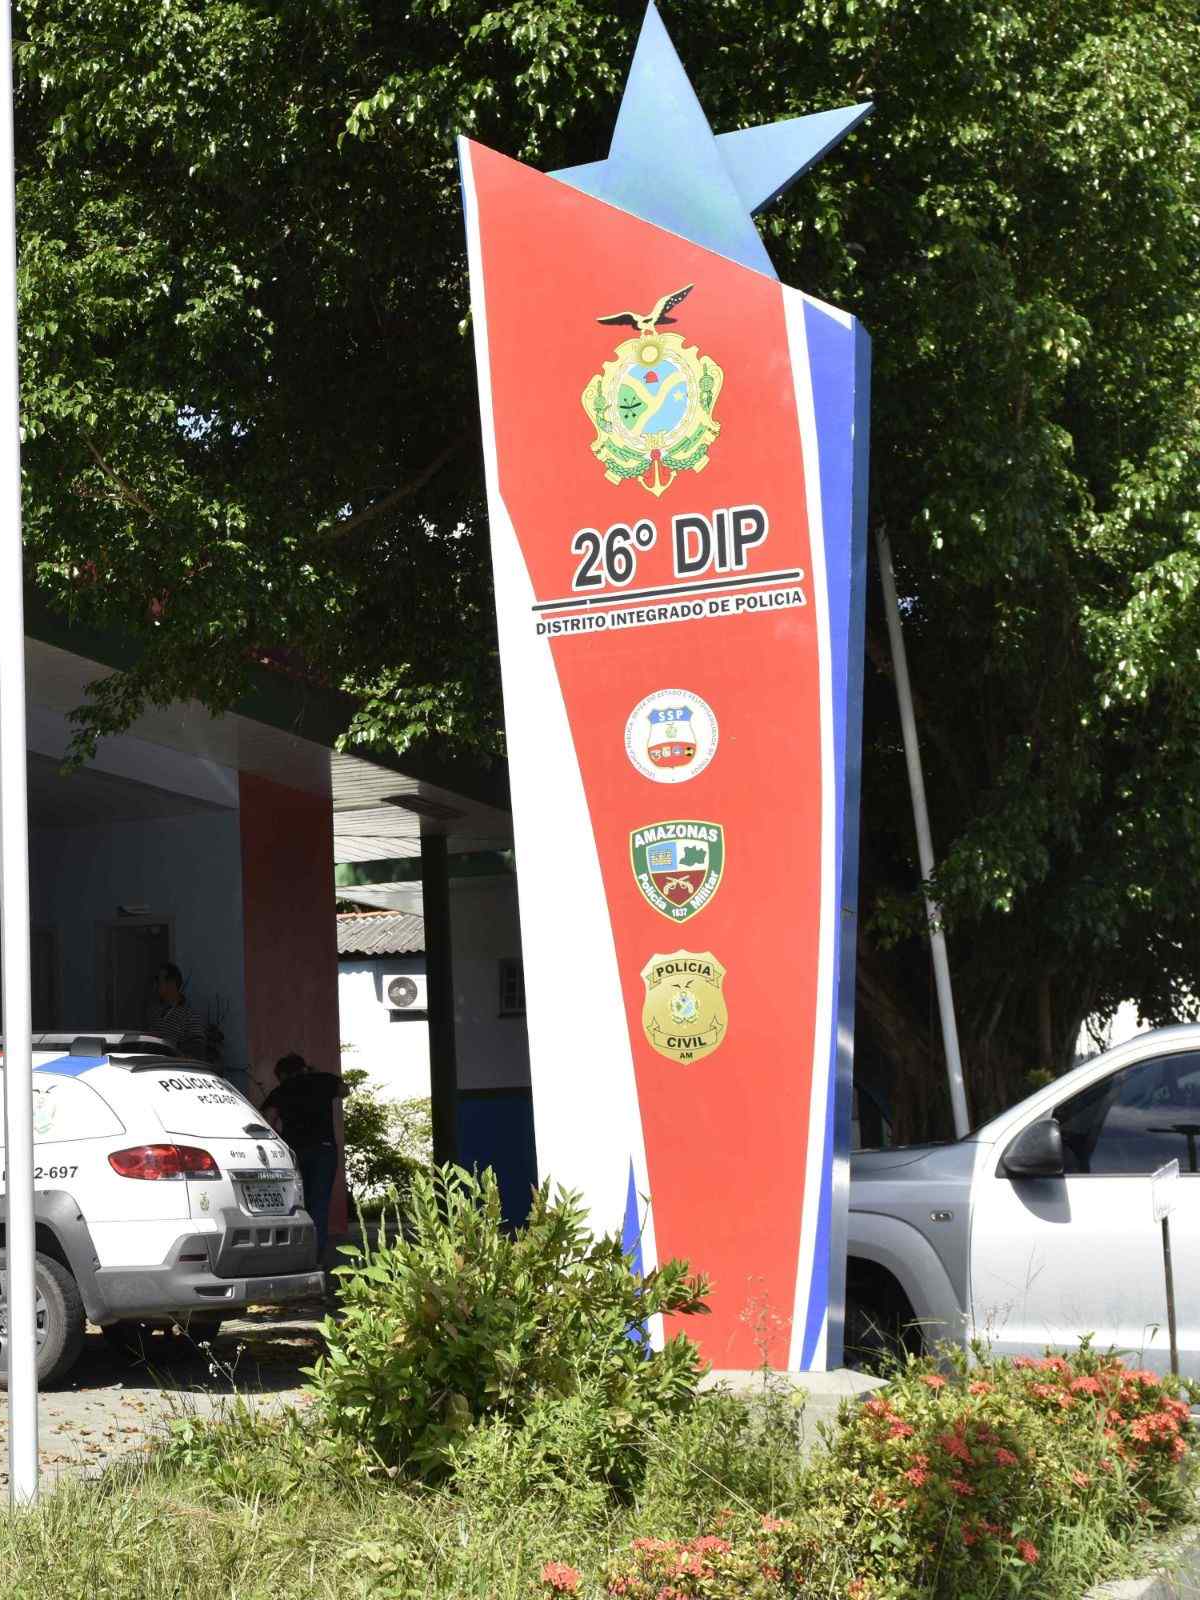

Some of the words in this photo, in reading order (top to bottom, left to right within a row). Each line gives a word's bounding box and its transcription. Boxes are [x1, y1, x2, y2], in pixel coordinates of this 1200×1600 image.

[675, 508, 766, 574] DIP
[536, 615, 606, 635] DISTRITO
[611, 603, 704, 626] INTEGRADO
[709, 600, 730, 614] DE
[735, 590, 802, 609] POLICIA
[658, 710, 683, 721] SSP
[634, 824, 719, 848] AMAZONAS
[690, 870, 719, 909] Militar
[667, 1036, 707, 1048] CIVIL
[158, 1075, 216, 1093] POLÍCIA
